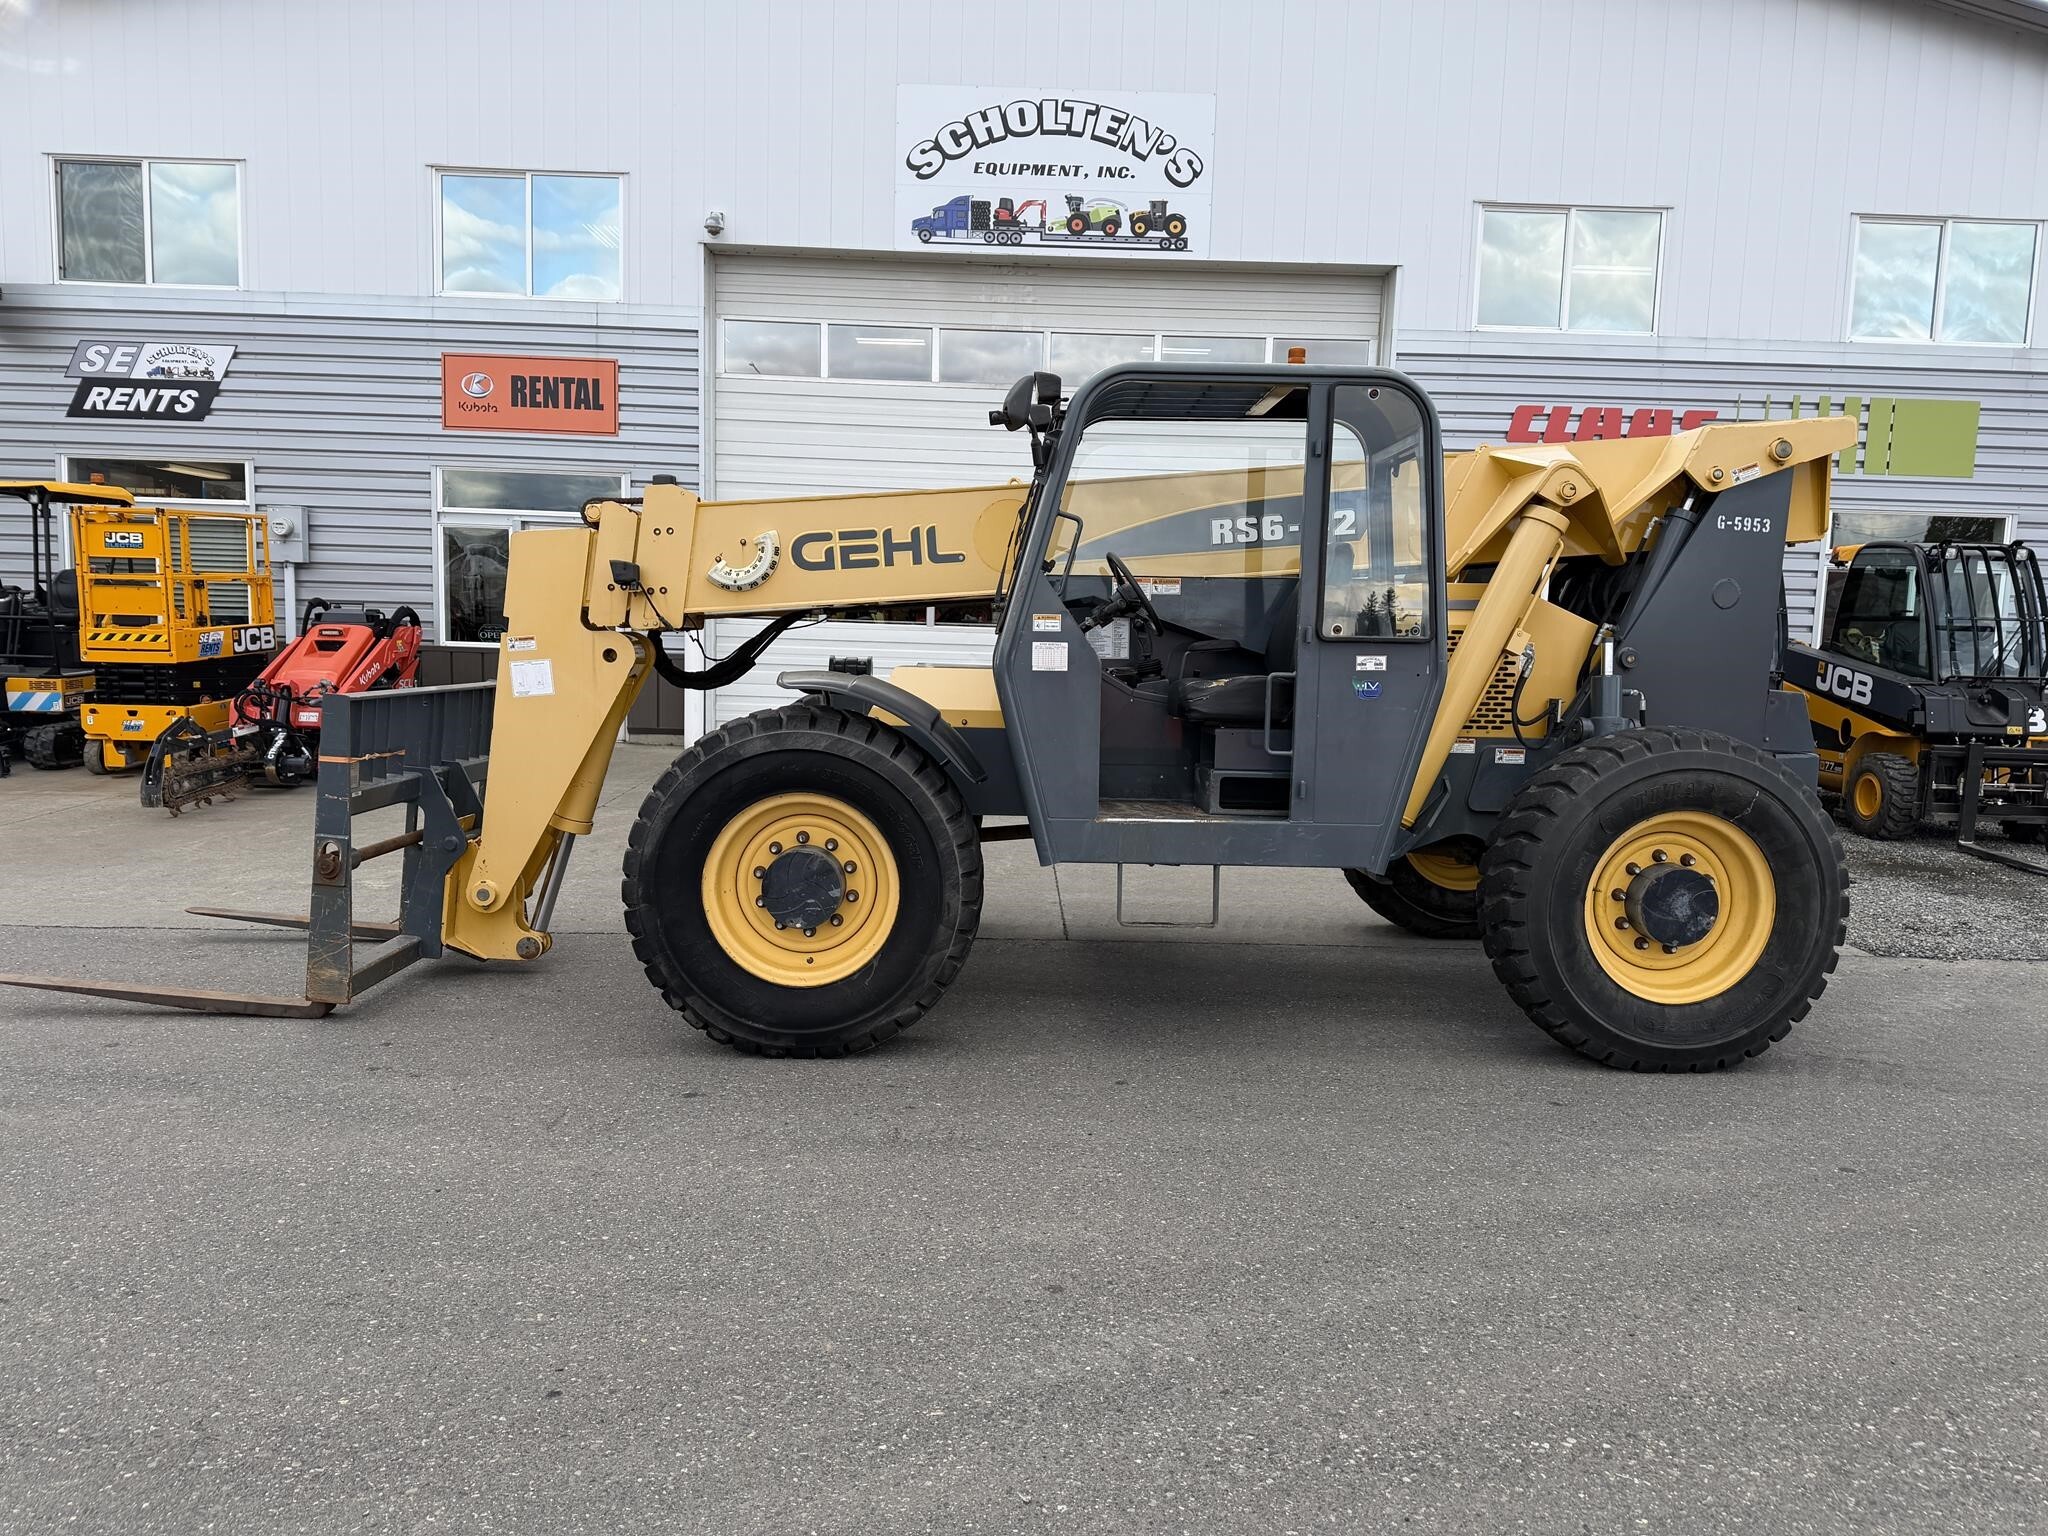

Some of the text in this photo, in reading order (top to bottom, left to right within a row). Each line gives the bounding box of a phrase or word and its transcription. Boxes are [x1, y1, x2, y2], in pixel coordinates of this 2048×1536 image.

[906, 98, 1204, 188] SCHOLTEN'S
[973, 161, 1136, 180] EQUIPMENT, INC.
[79, 344, 139, 373] SE
[82, 386, 200, 414] RENTS
[510, 374, 604, 411] RENTAL
[458, 401, 498, 413] Kubota
[1211, 509, 1356, 545] RS6-2
[1717, 515, 1771, 533] G-5953
[105, 532, 143, 544] JCB
[791, 525, 966, 571] GEHL
[761, 572, 770, 581] 40
[199, 633, 210, 643] SE
[234, 627, 275, 652] JCB
[480, 631, 500, 639] OPE
[201, 643, 220, 652] RENTS
[359, 662, 381, 685] Kubota
[1816, 663, 1873, 705] JCB
